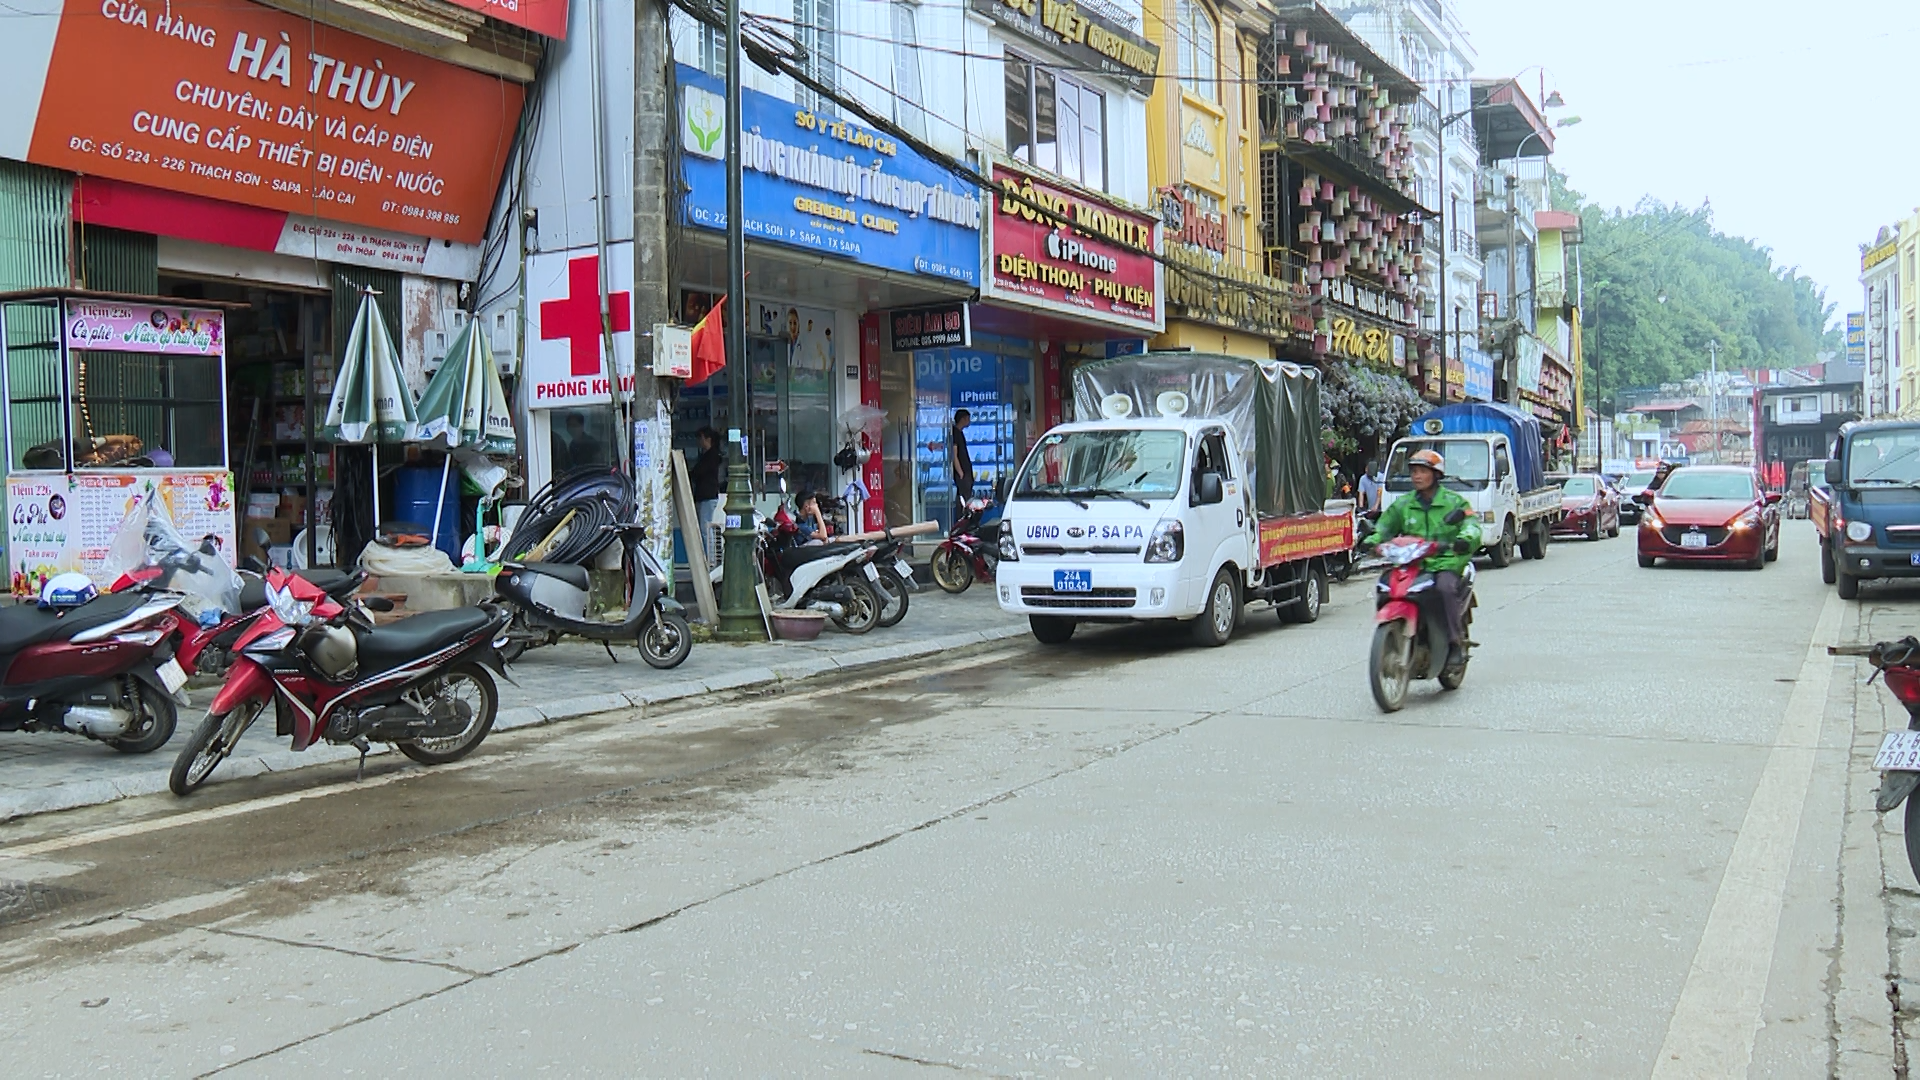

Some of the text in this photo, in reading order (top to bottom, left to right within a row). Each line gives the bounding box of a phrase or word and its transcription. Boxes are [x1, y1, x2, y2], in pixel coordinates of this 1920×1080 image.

[101, 0, 216, 48] CỬA HÀNG
[228, 31, 416, 115] HÀ THÙY
[1089, 25, 1125, 60] GUEST
[1121, 41, 1158, 75] HOUSE
[175, 79, 434, 160] CHUYÊN: DÂY VÀ CÁP ĐIỆN
[794, 108, 897, 157] SỞ Y TẾ LÀO CAI
[69, 136, 97, 153] ĐC:
[100, 141, 122, 159] SỐ
[124, 148, 151, 164] 224
[161, 155, 186, 172] 226
[189, 161, 232, 182] THẠCH
[234, 170, 262, 186] SƠN
[271, 178, 302, 194] SAPA
[312, 186, 335, 202] LÀO
[336, 191, 356, 206] CAI
[132, 110, 201, 145] CUNG
[205, 125, 252, 154] CẤP
[257, 138, 315, 168] THIẾT
[317, 153, 338, 178] BỊ
[340, 158, 385, 184] ĐIỆN
[395, 170, 446, 197] NƯỚC
[742, 125, 786, 177] HÒNG
[787, 144, 834, 190] KHÁM
[834, 155, 861, 202] NỘI
[861, 158, 901, 209] TỔNG
[900, 179, 929, 219] HỢP
[381, 200, 401, 214] ĐT:
[401, 204, 425, 219] 0984
[794, 197, 859, 226] GRENERAL
[862, 213, 899, 236] CLINIC
[1074, 203, 1150, 253] MOBILE
[1184, 199, 1227, 255] Hotel
[800, 231, 821, 245] SAPA
[828, 238, 839, 249] TX
[839, 243, 861, 254] SAPA
[1062, 239, 1117, 274] iPhone
[1001, 252, 1038, 281] ĐIỆN
[1040, 263, 1084, 293] THOẠI
[1095, 277, 1122, 303] PHỤ
[1125, 286, 1153, 310] KIỆN
[924, 312, 942, 333] ÂM
[537, 380, 587, 399] PHÒNG
[12, 485, 34, 499] Tiệm
[25, 549, 59, 560] Take away
[1026, 525, 1143, 538] UBND P. SA PA
